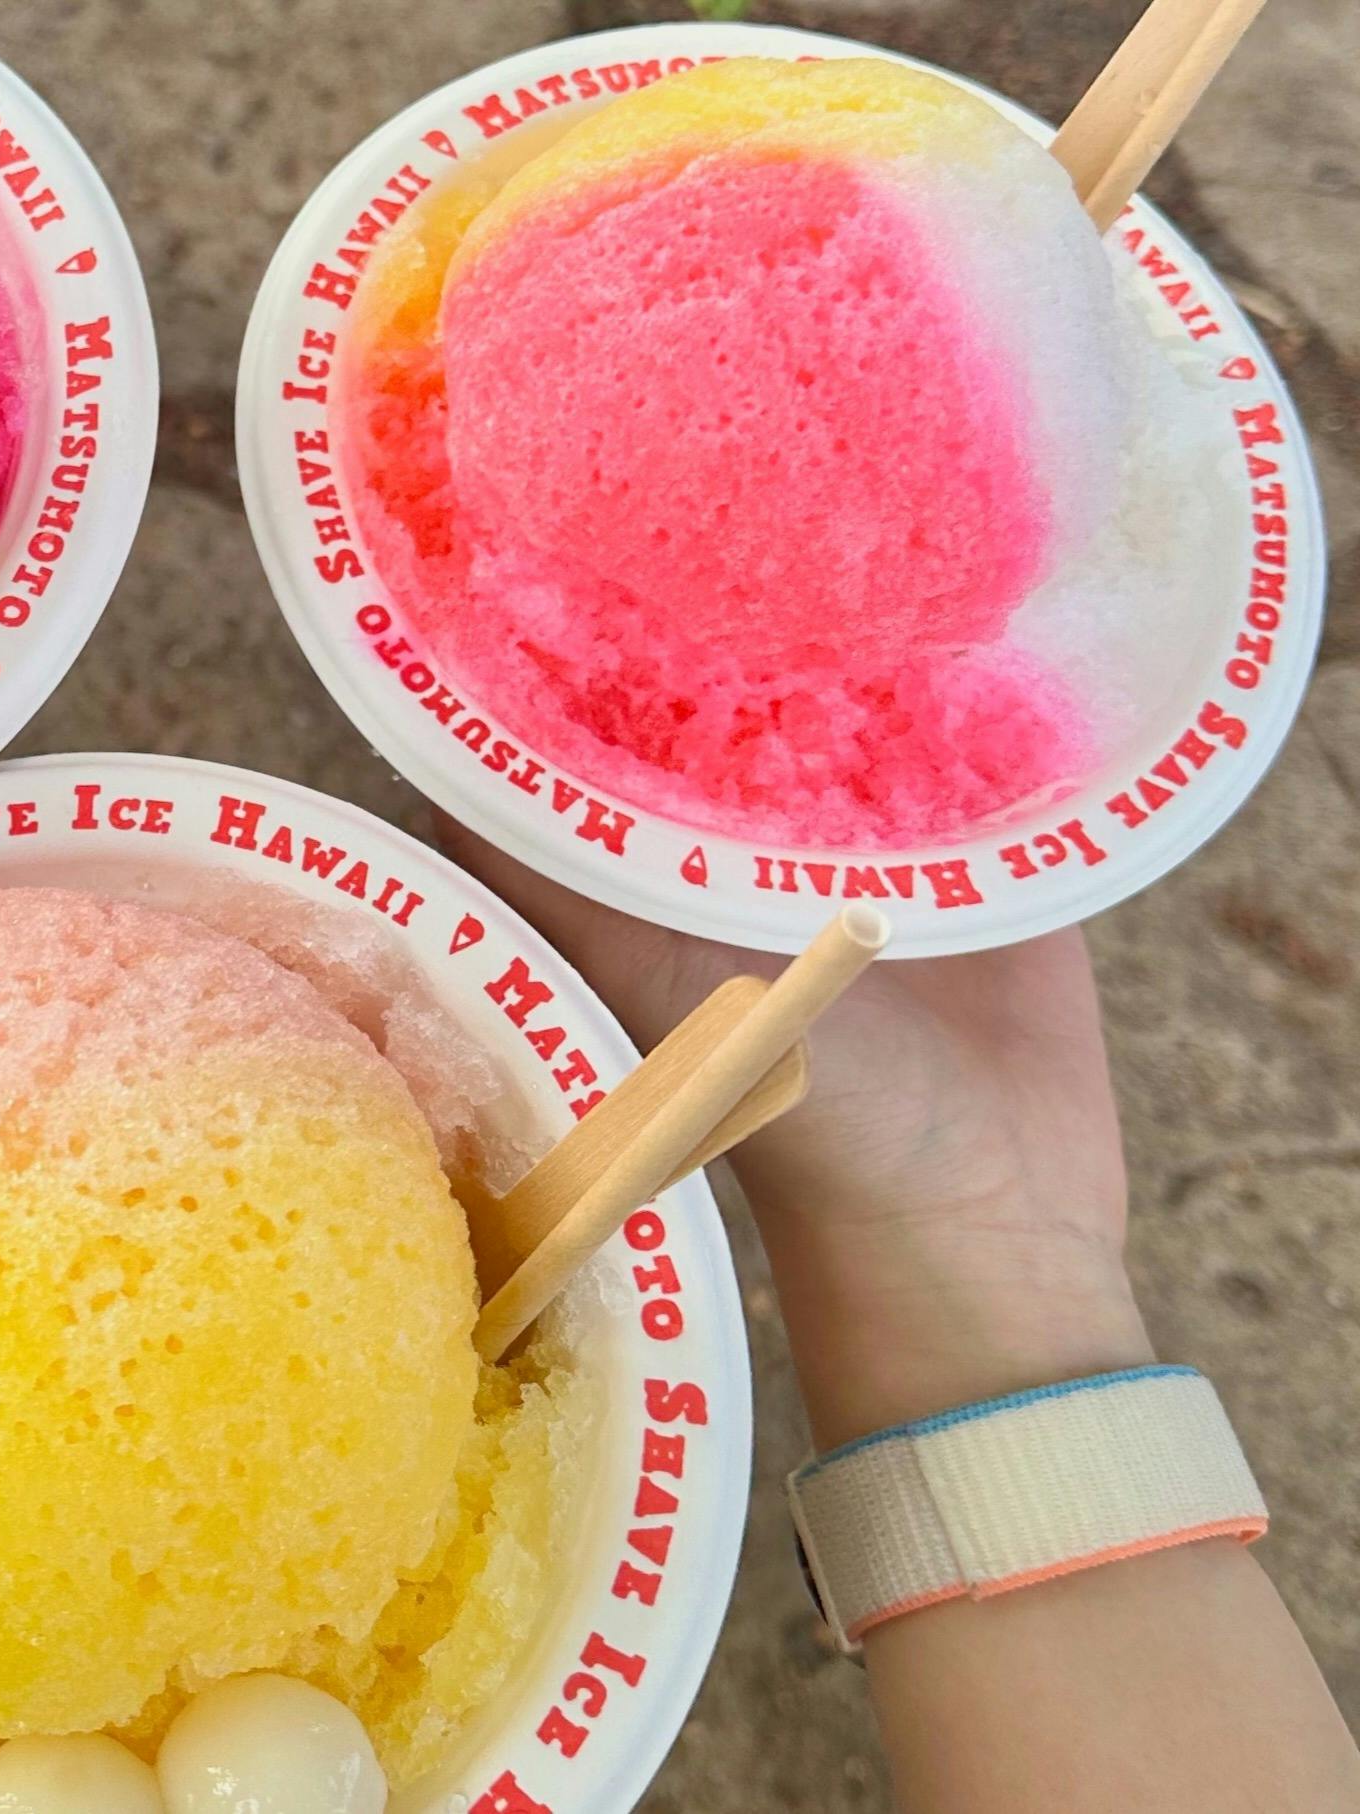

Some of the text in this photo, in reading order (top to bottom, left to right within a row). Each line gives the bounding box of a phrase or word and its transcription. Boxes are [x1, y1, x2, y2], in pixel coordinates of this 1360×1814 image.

[1115, 205, 1221, 342] AWAII
[282, 165, 636, 857] MATSUMOTO SHAVE ICE HAWAII
[753, 403, 1288, 909] MATSUMOTO SHAVE ICE HAWAII
[72, 784, 174, 835] ICE
[210, 796, 424, 928] HAWAII
[612, 1378, 708, 1606] SHAVE
[537, 1632, 647, 1759] ICE
